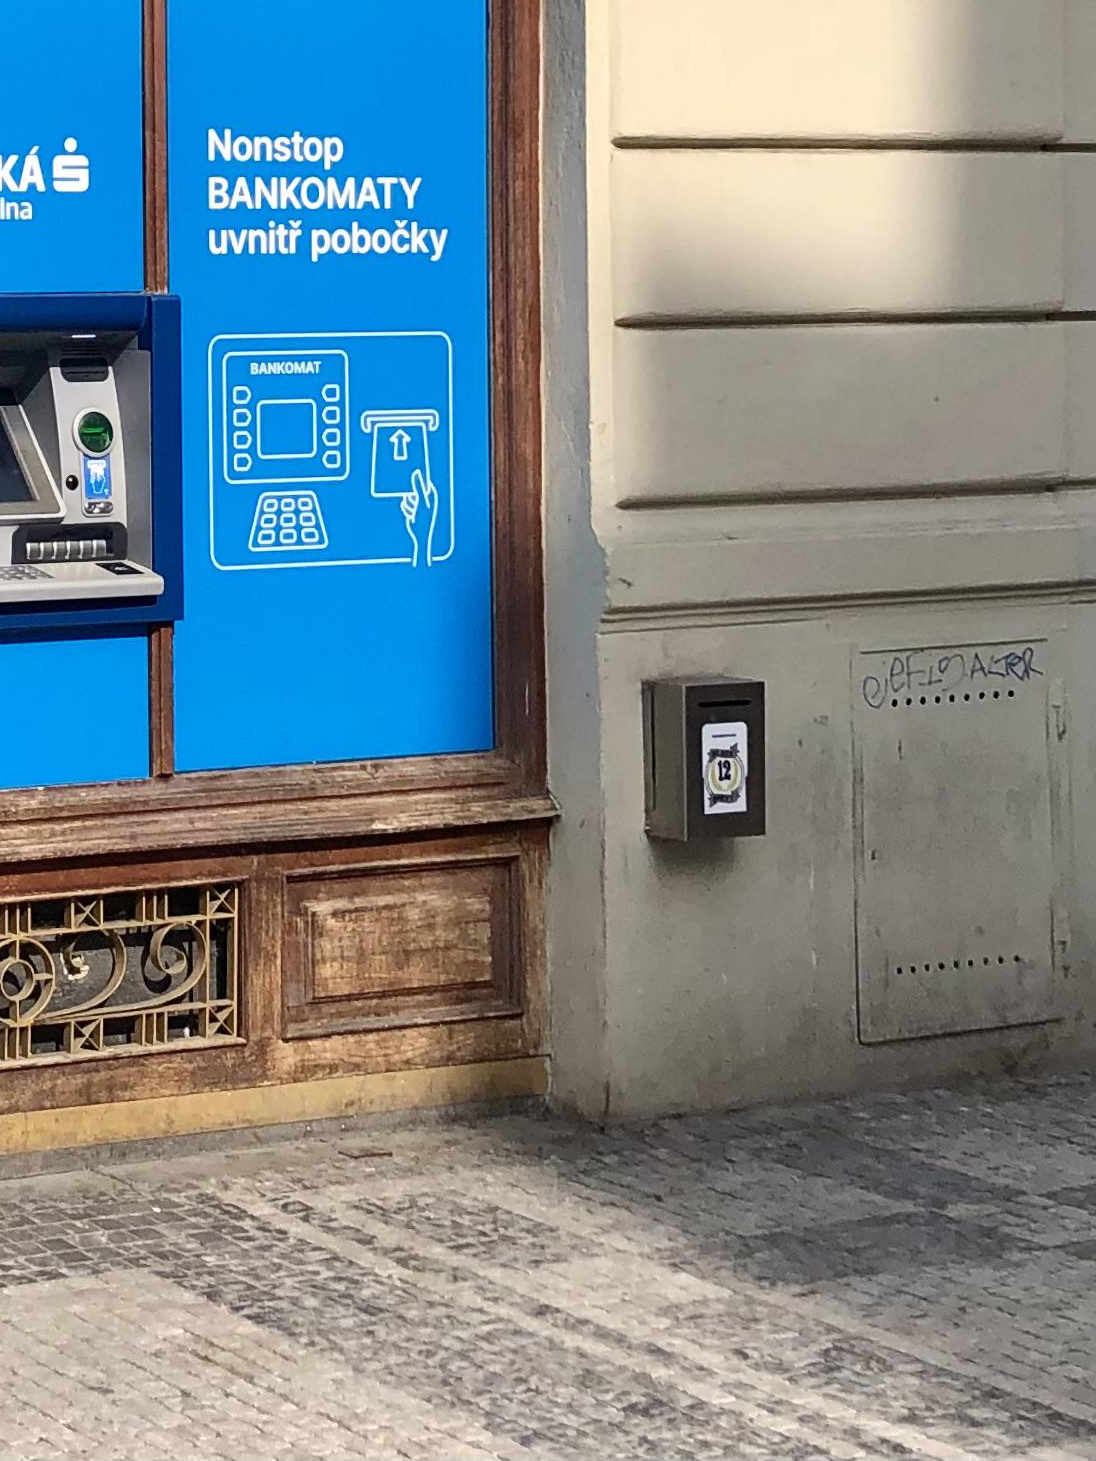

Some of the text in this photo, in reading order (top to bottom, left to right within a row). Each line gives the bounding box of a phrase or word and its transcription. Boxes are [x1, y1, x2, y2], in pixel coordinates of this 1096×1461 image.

[207, 128, 344, 170] Nonstop
[207, 176, 422, 210] BANKOMATY
[207, 220, 449, 262] uvnitř pobočky
[250, 361, 322, 375] BANKOMAT
[717, 760, 732, 781] 12
